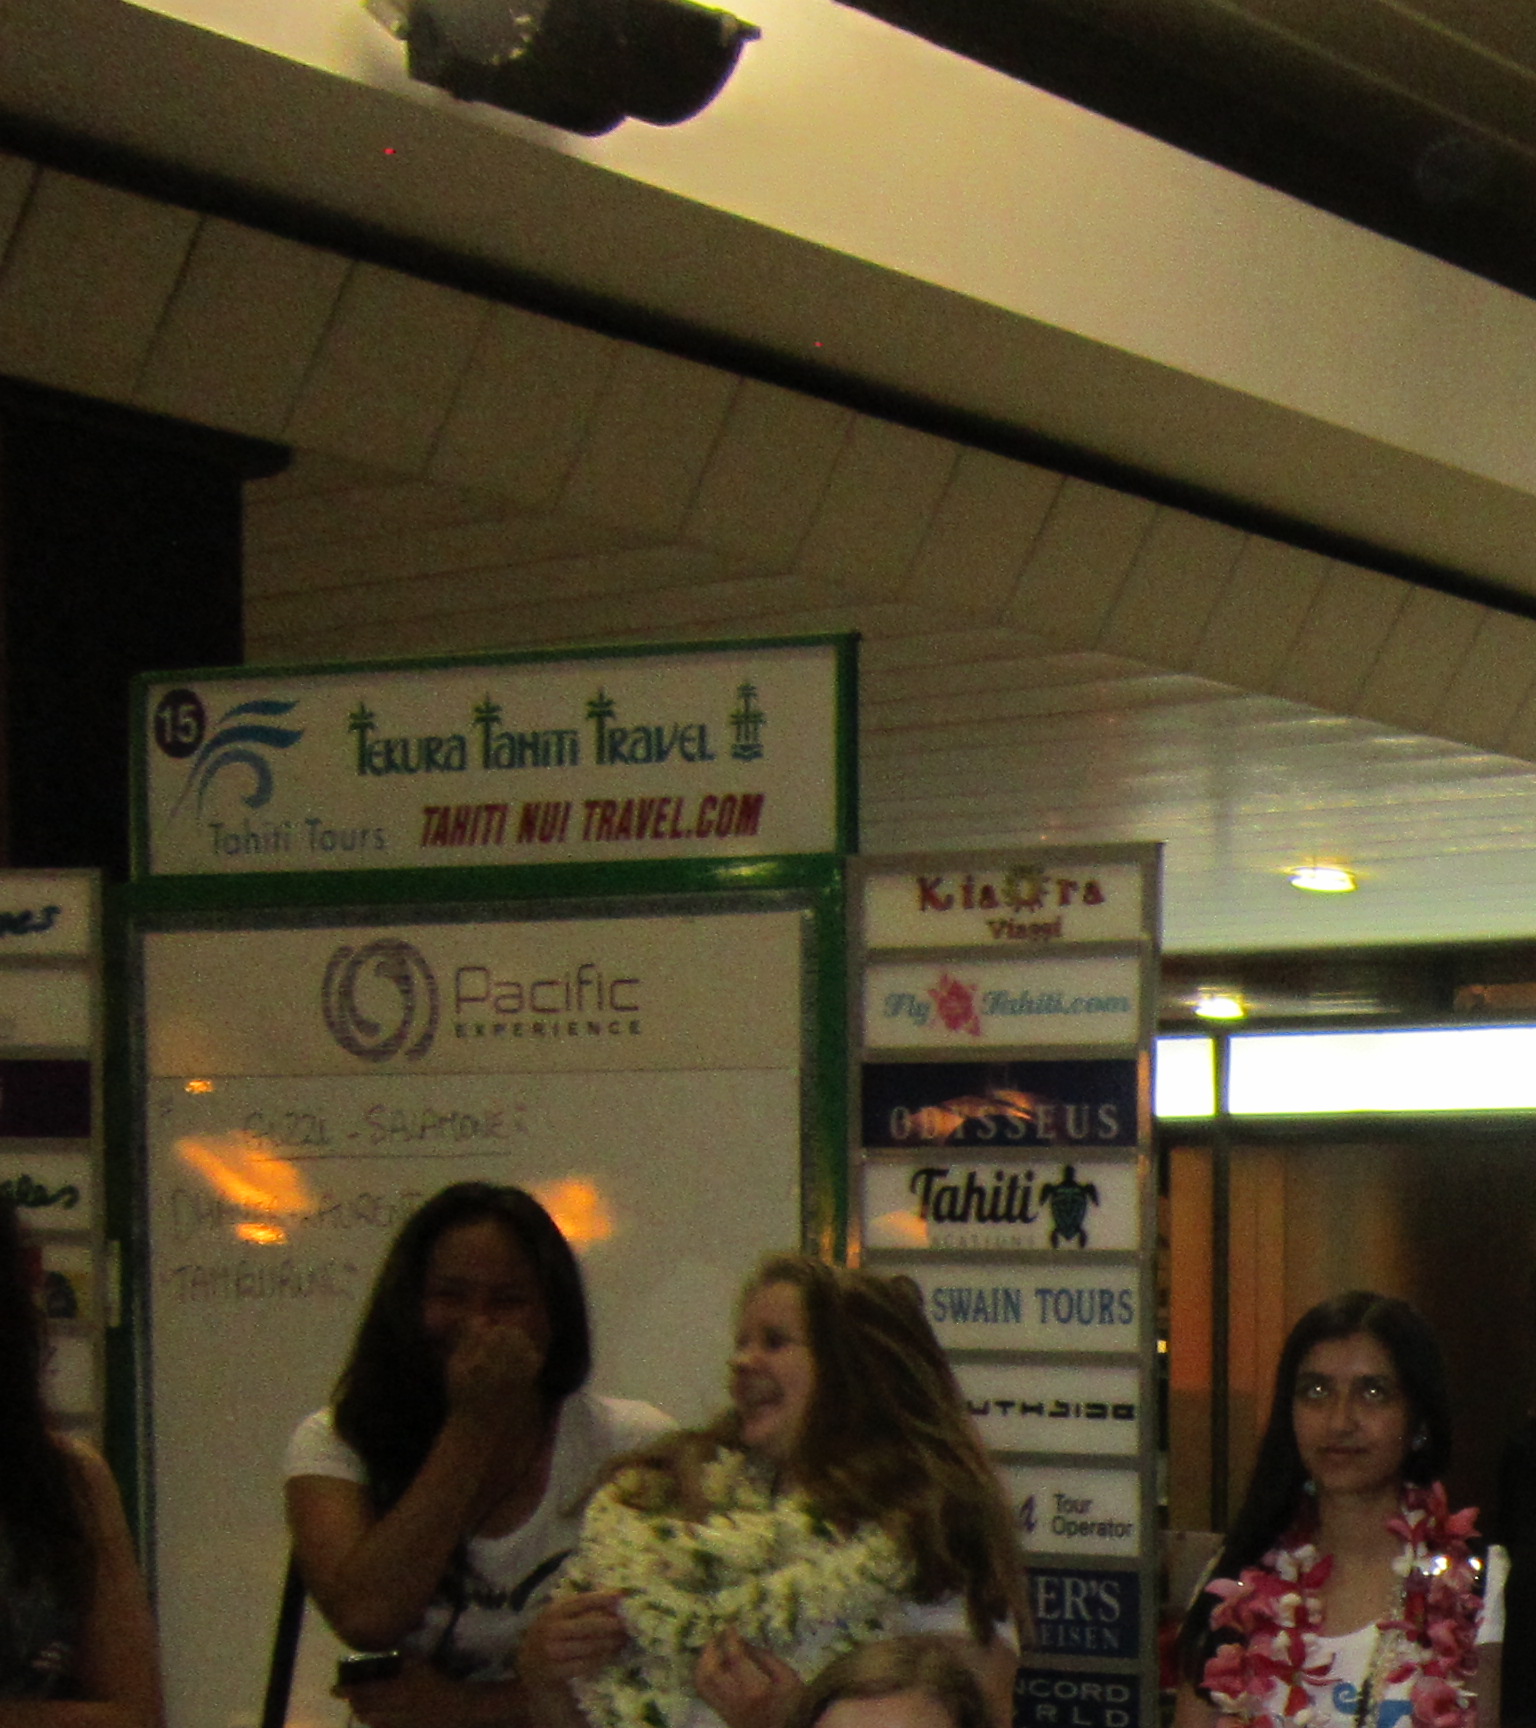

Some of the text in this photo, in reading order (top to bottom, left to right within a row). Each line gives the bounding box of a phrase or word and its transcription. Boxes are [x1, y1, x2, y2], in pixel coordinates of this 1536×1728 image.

[158, 704, 196, 742] 15
[208, 817, 385, 855] Tahiti Tours
[421, 793, 767, 847] TAHITI NUI TRAVEL.COM
[915, 875, 999, 912] Kia
[456, 963, 640, 1014] Pacific
[455, 1019, 642, 1038] EXPERIENCE
[889, 1104, 1121, 1140] ODYSSEUS
[910, 1167, 1039, 1225] Tahiti
[933, 1287, 1134, 1325] SWAIN TOURS
[967, 1400, 1136, 1421] UTHSIDE
[1053, 1493, 1096, 1514] Tour
[1052, 1515, 1133, 1541] Operator
[1034, 1576, 1121, 1623] ER'S
[1041, 1622, 1121, 1650] EISEN
[1015, 1678, 1130, 1703] NCORD
[1035, 1702, 1130, 1728] RLD
